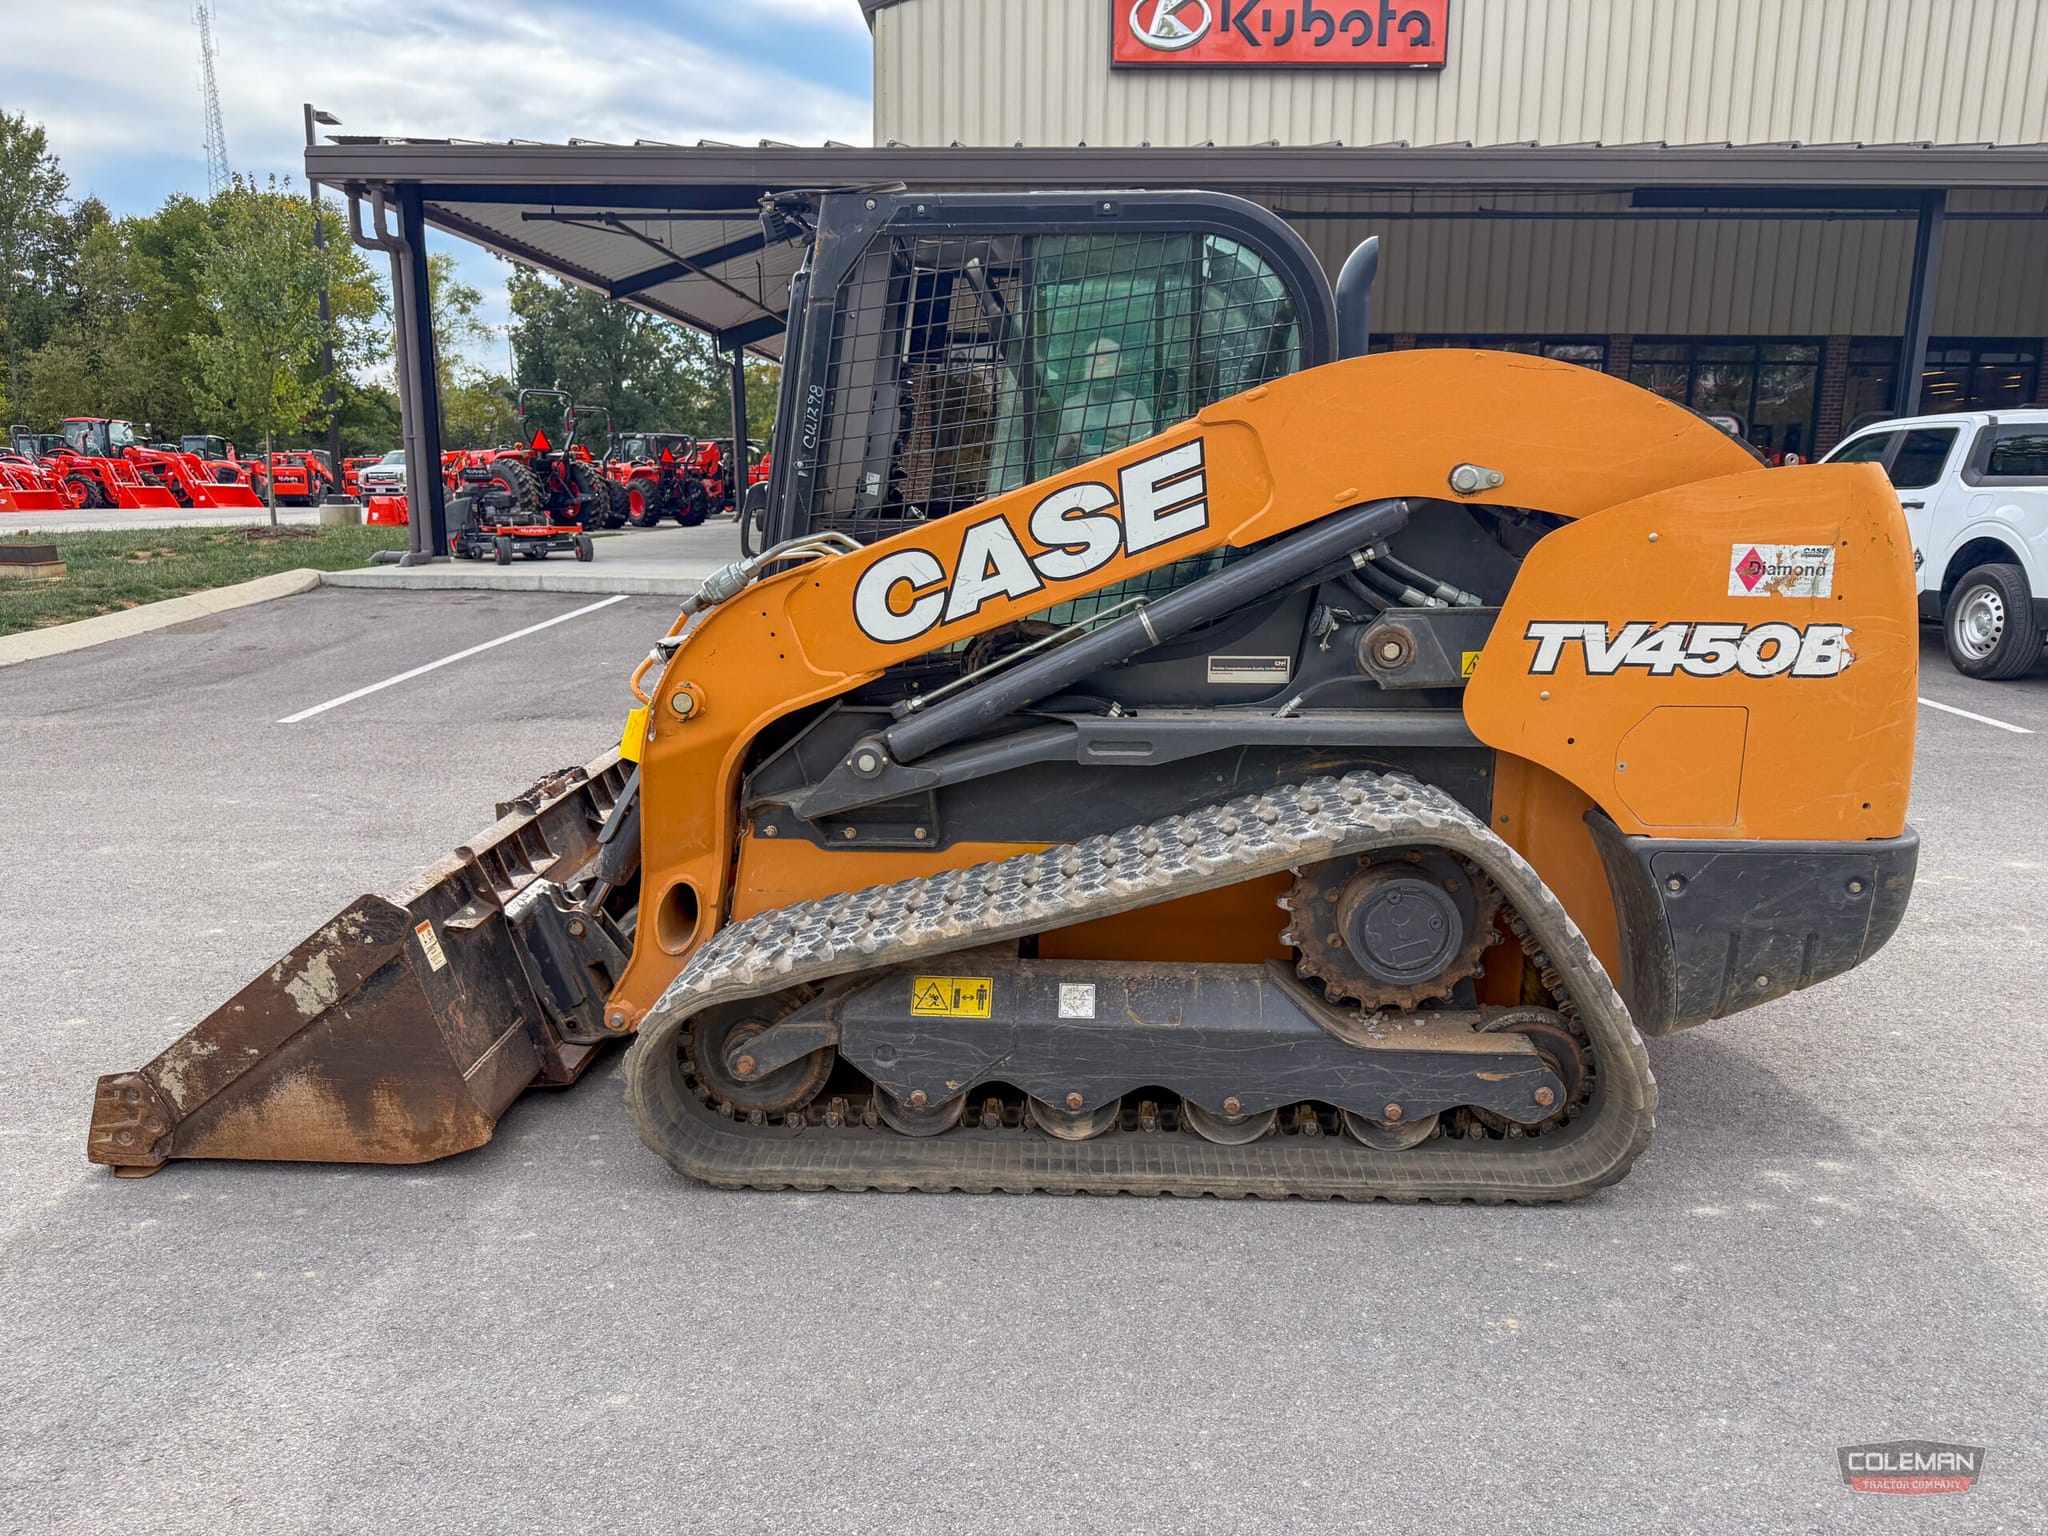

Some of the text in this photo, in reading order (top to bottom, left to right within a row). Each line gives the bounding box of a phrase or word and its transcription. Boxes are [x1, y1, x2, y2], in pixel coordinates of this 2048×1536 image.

[1221, 0, 1431, 47] Kubota
[853, 436, 1210, 645] CASE
[1749, 561, 1826, 577] Diamond
[1523, 620, 1857, 679] TV450B
